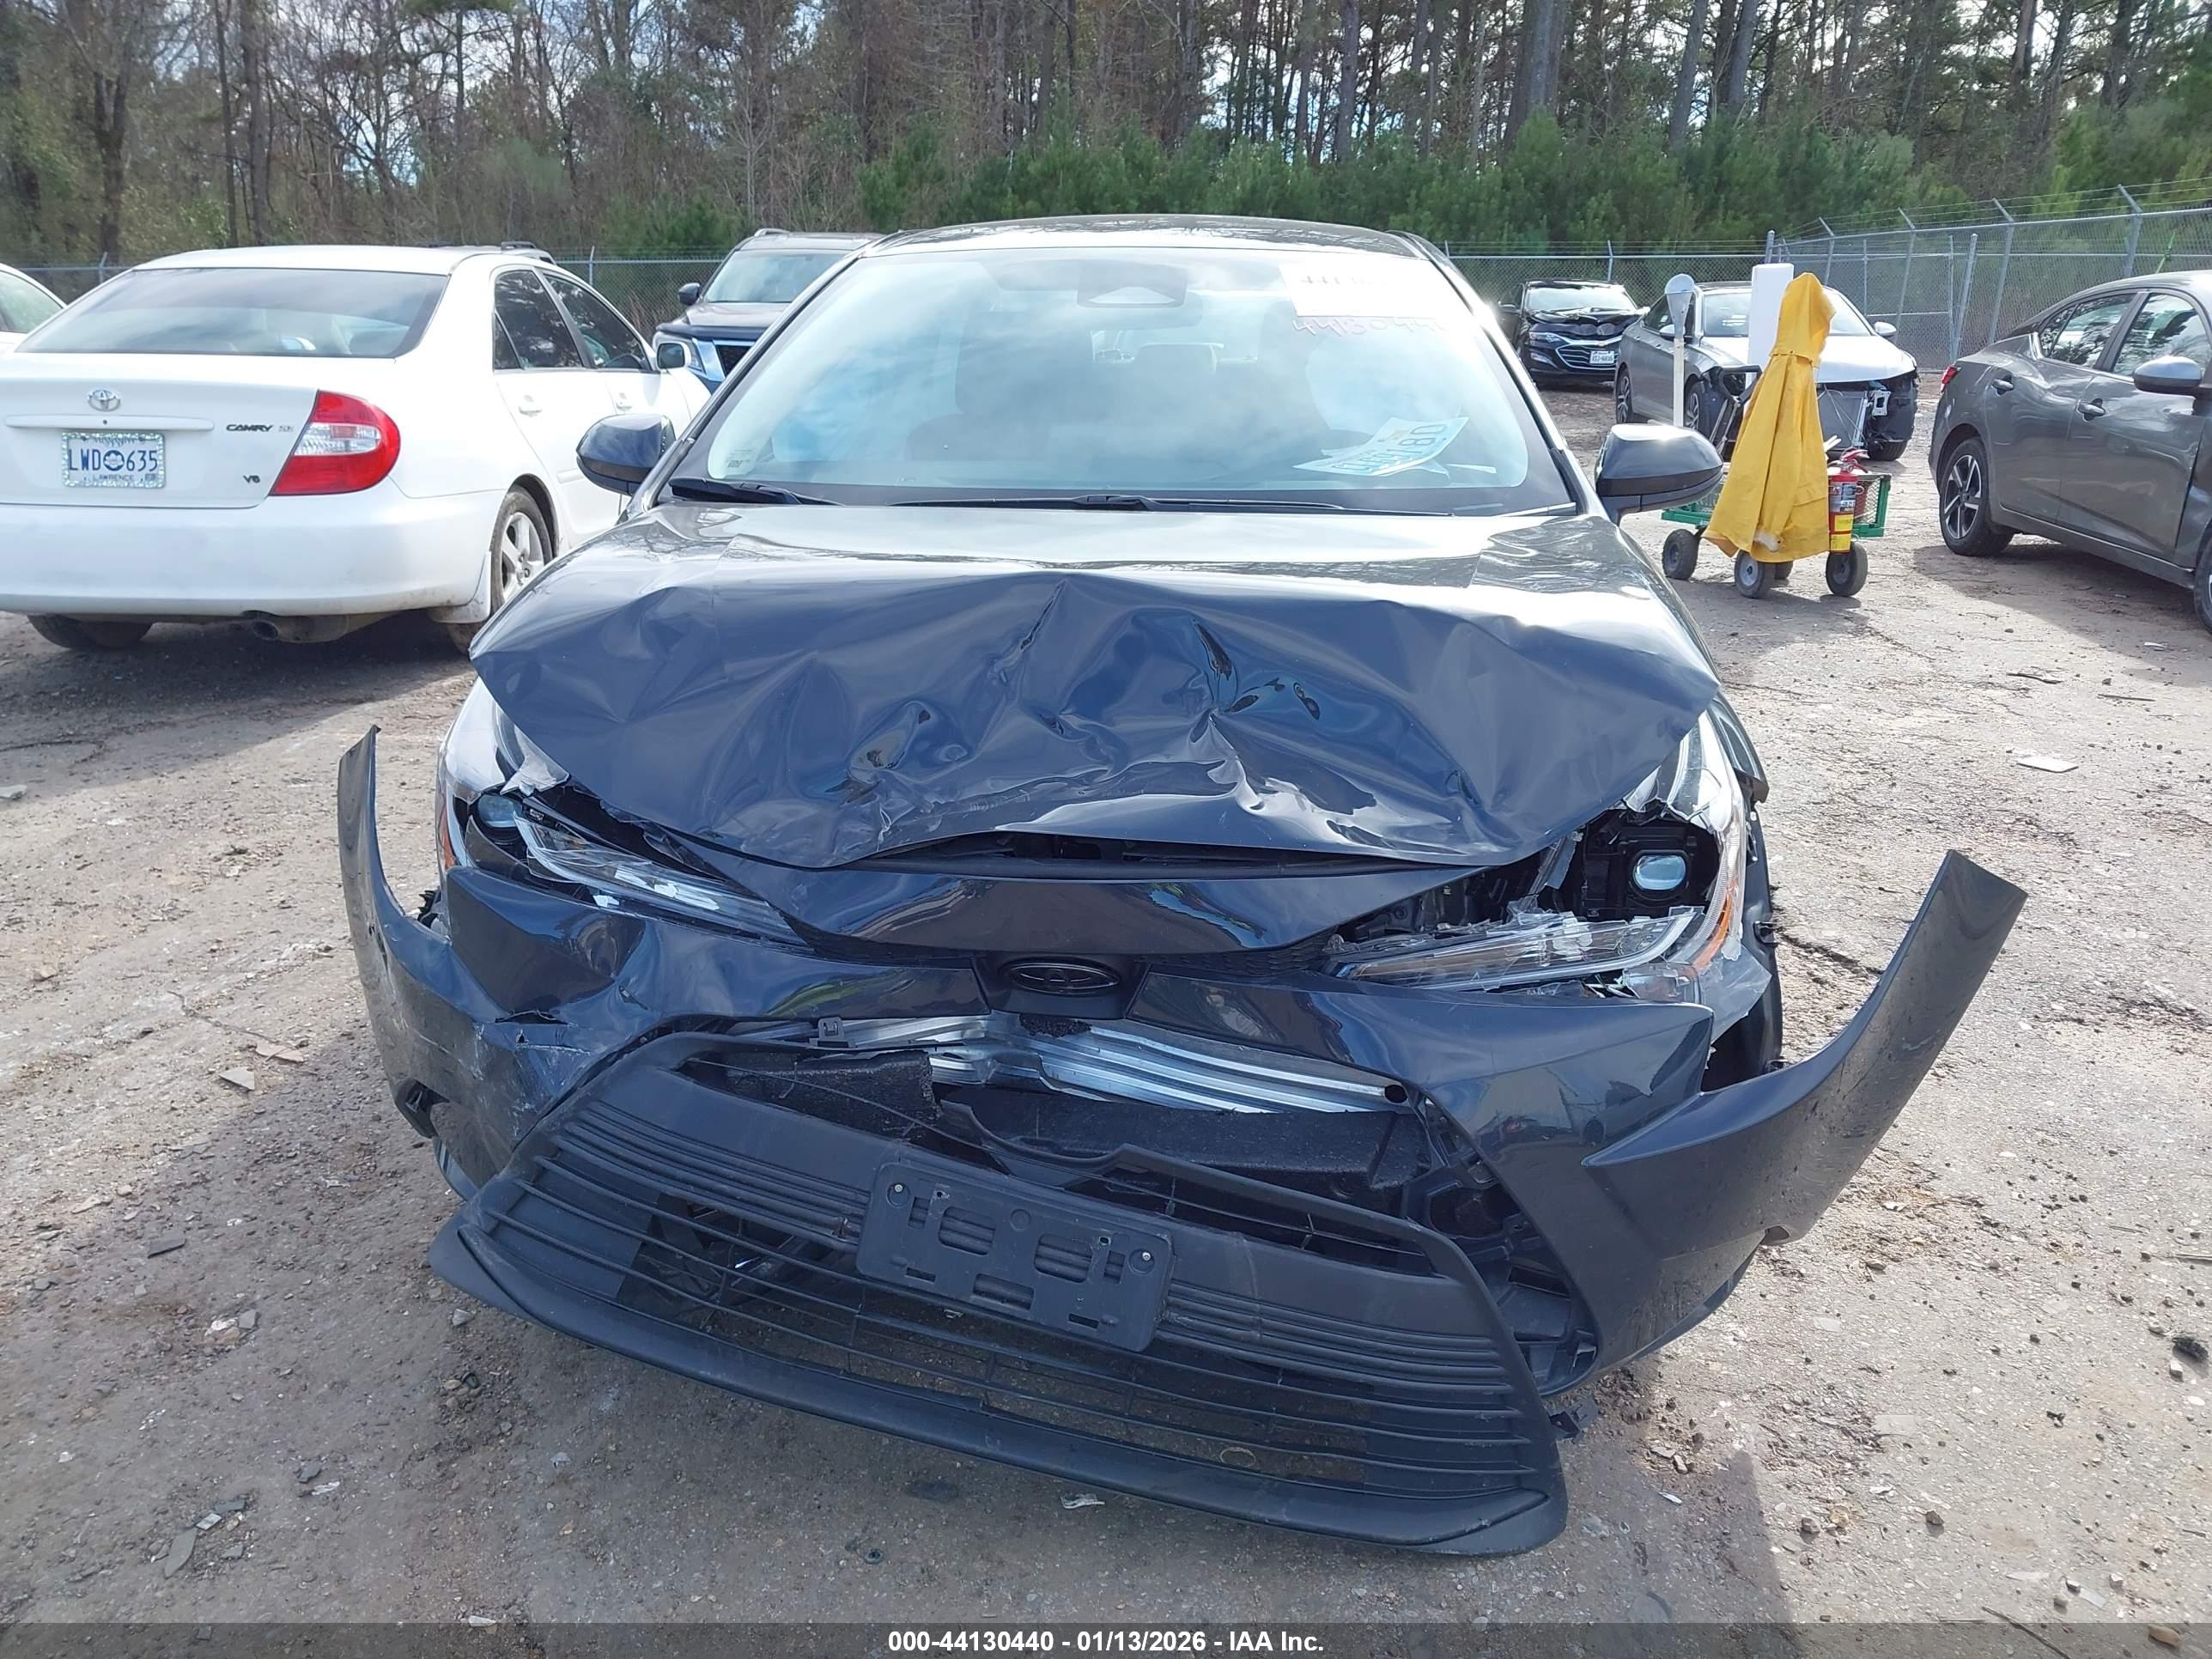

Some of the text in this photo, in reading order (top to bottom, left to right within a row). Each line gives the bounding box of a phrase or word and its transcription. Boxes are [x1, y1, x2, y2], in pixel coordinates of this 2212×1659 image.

[226, 423, 274, 432] CAMRY
[69, 448, 158, 472] LWD 635
[242, 474, 261, 485] V6
